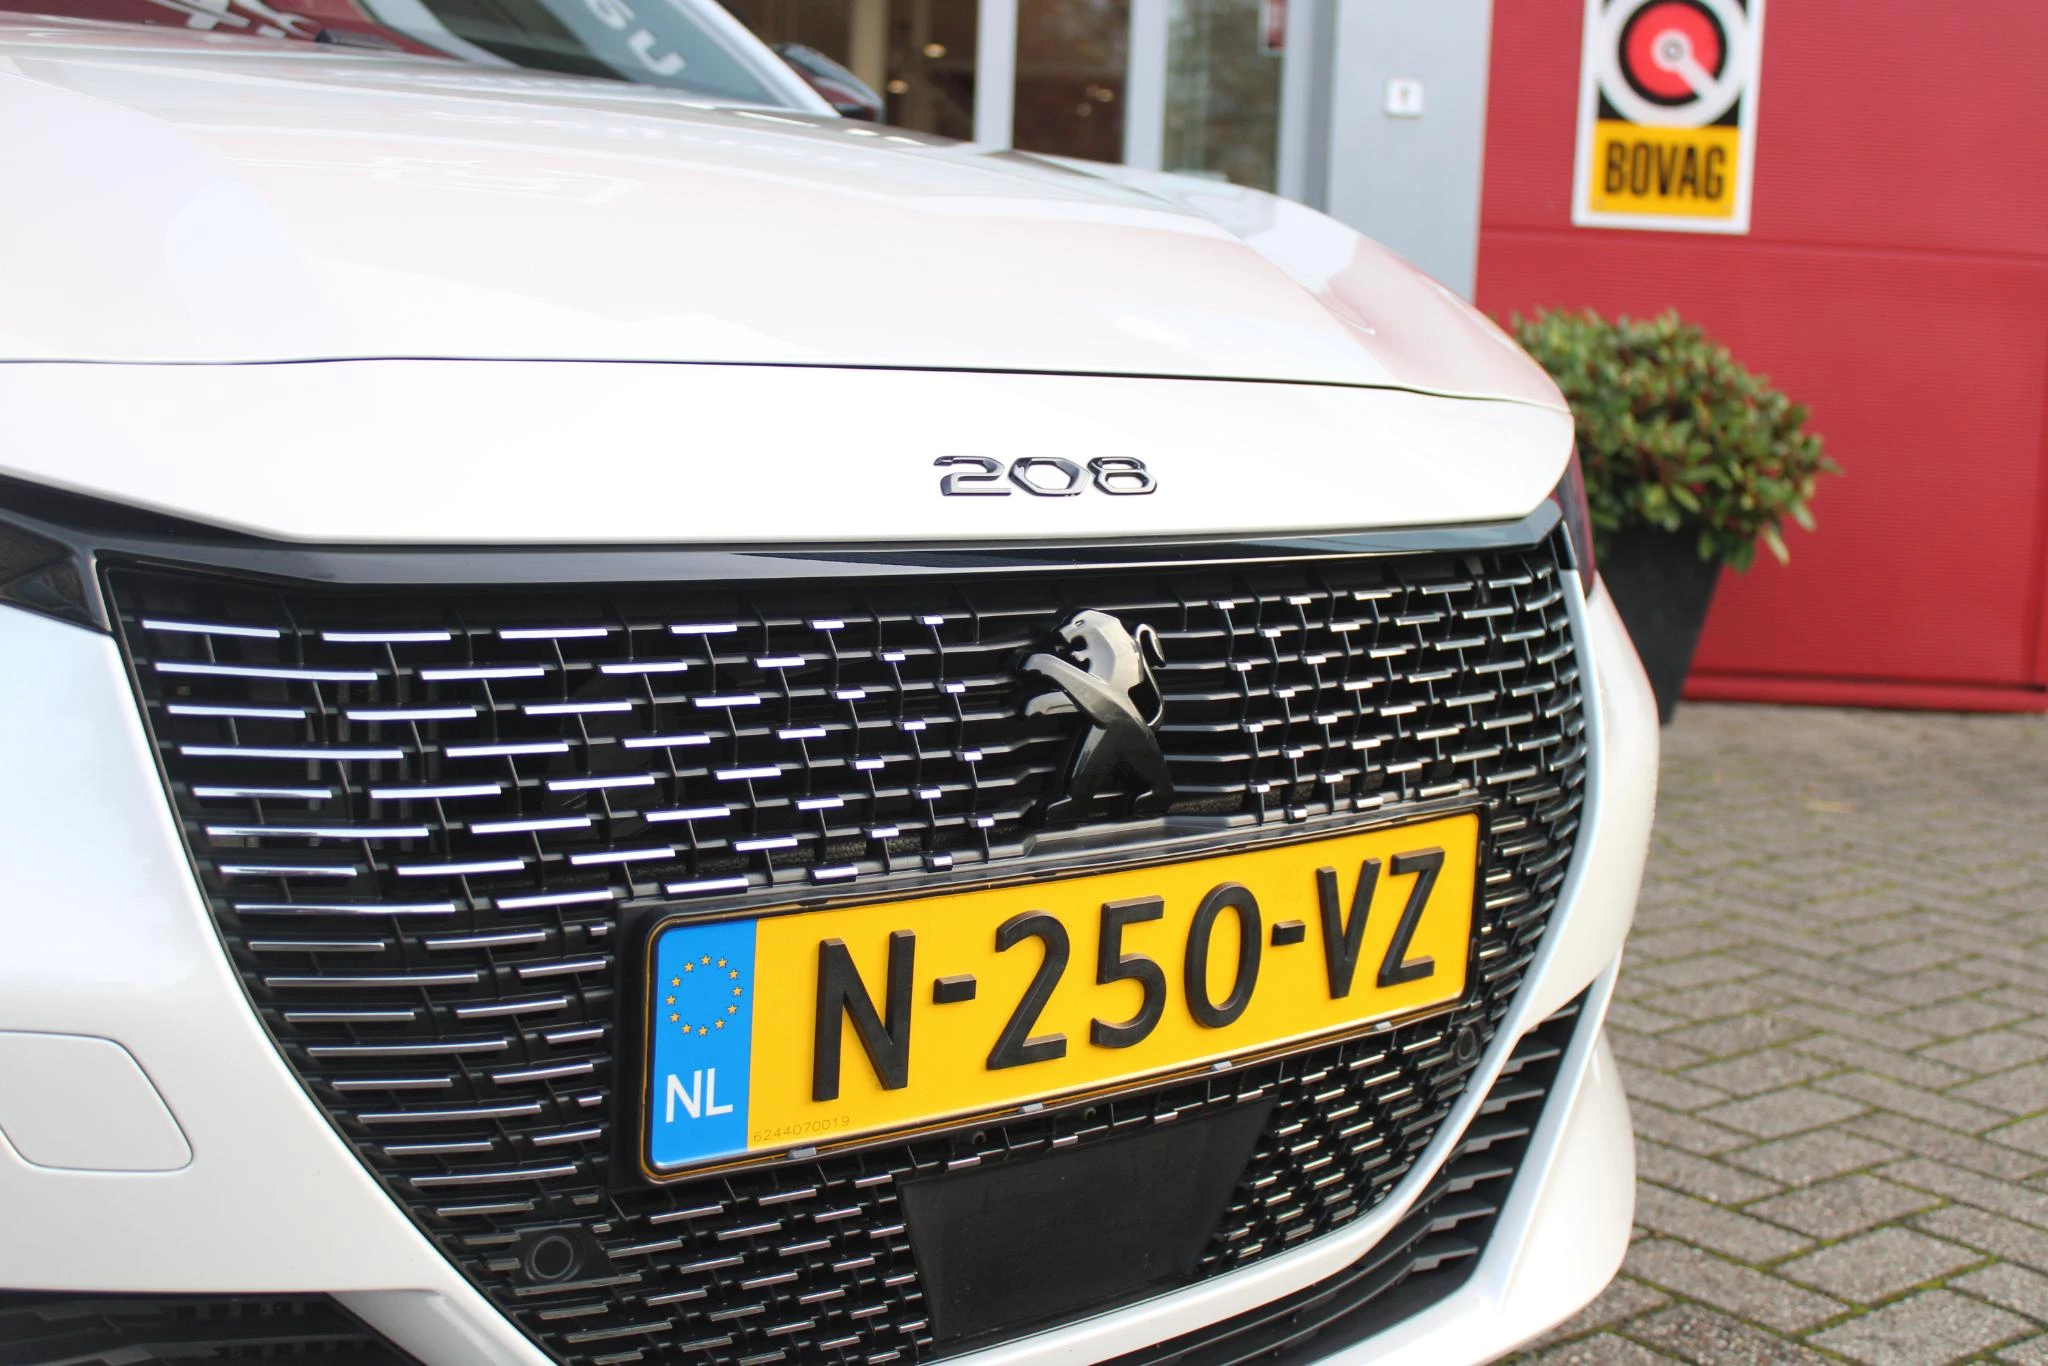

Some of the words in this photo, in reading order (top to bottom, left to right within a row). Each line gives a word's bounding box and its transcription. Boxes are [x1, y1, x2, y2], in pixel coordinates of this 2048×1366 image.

[1605, 138, 1726, 203] BOVAG
[934, 455, 1157, 497] 208
[812, 846, 1445, 1102] N-250-VZ
[666, 1067, 733, 1123] NL
[752, 1115, 851, 1143] 6244070019
